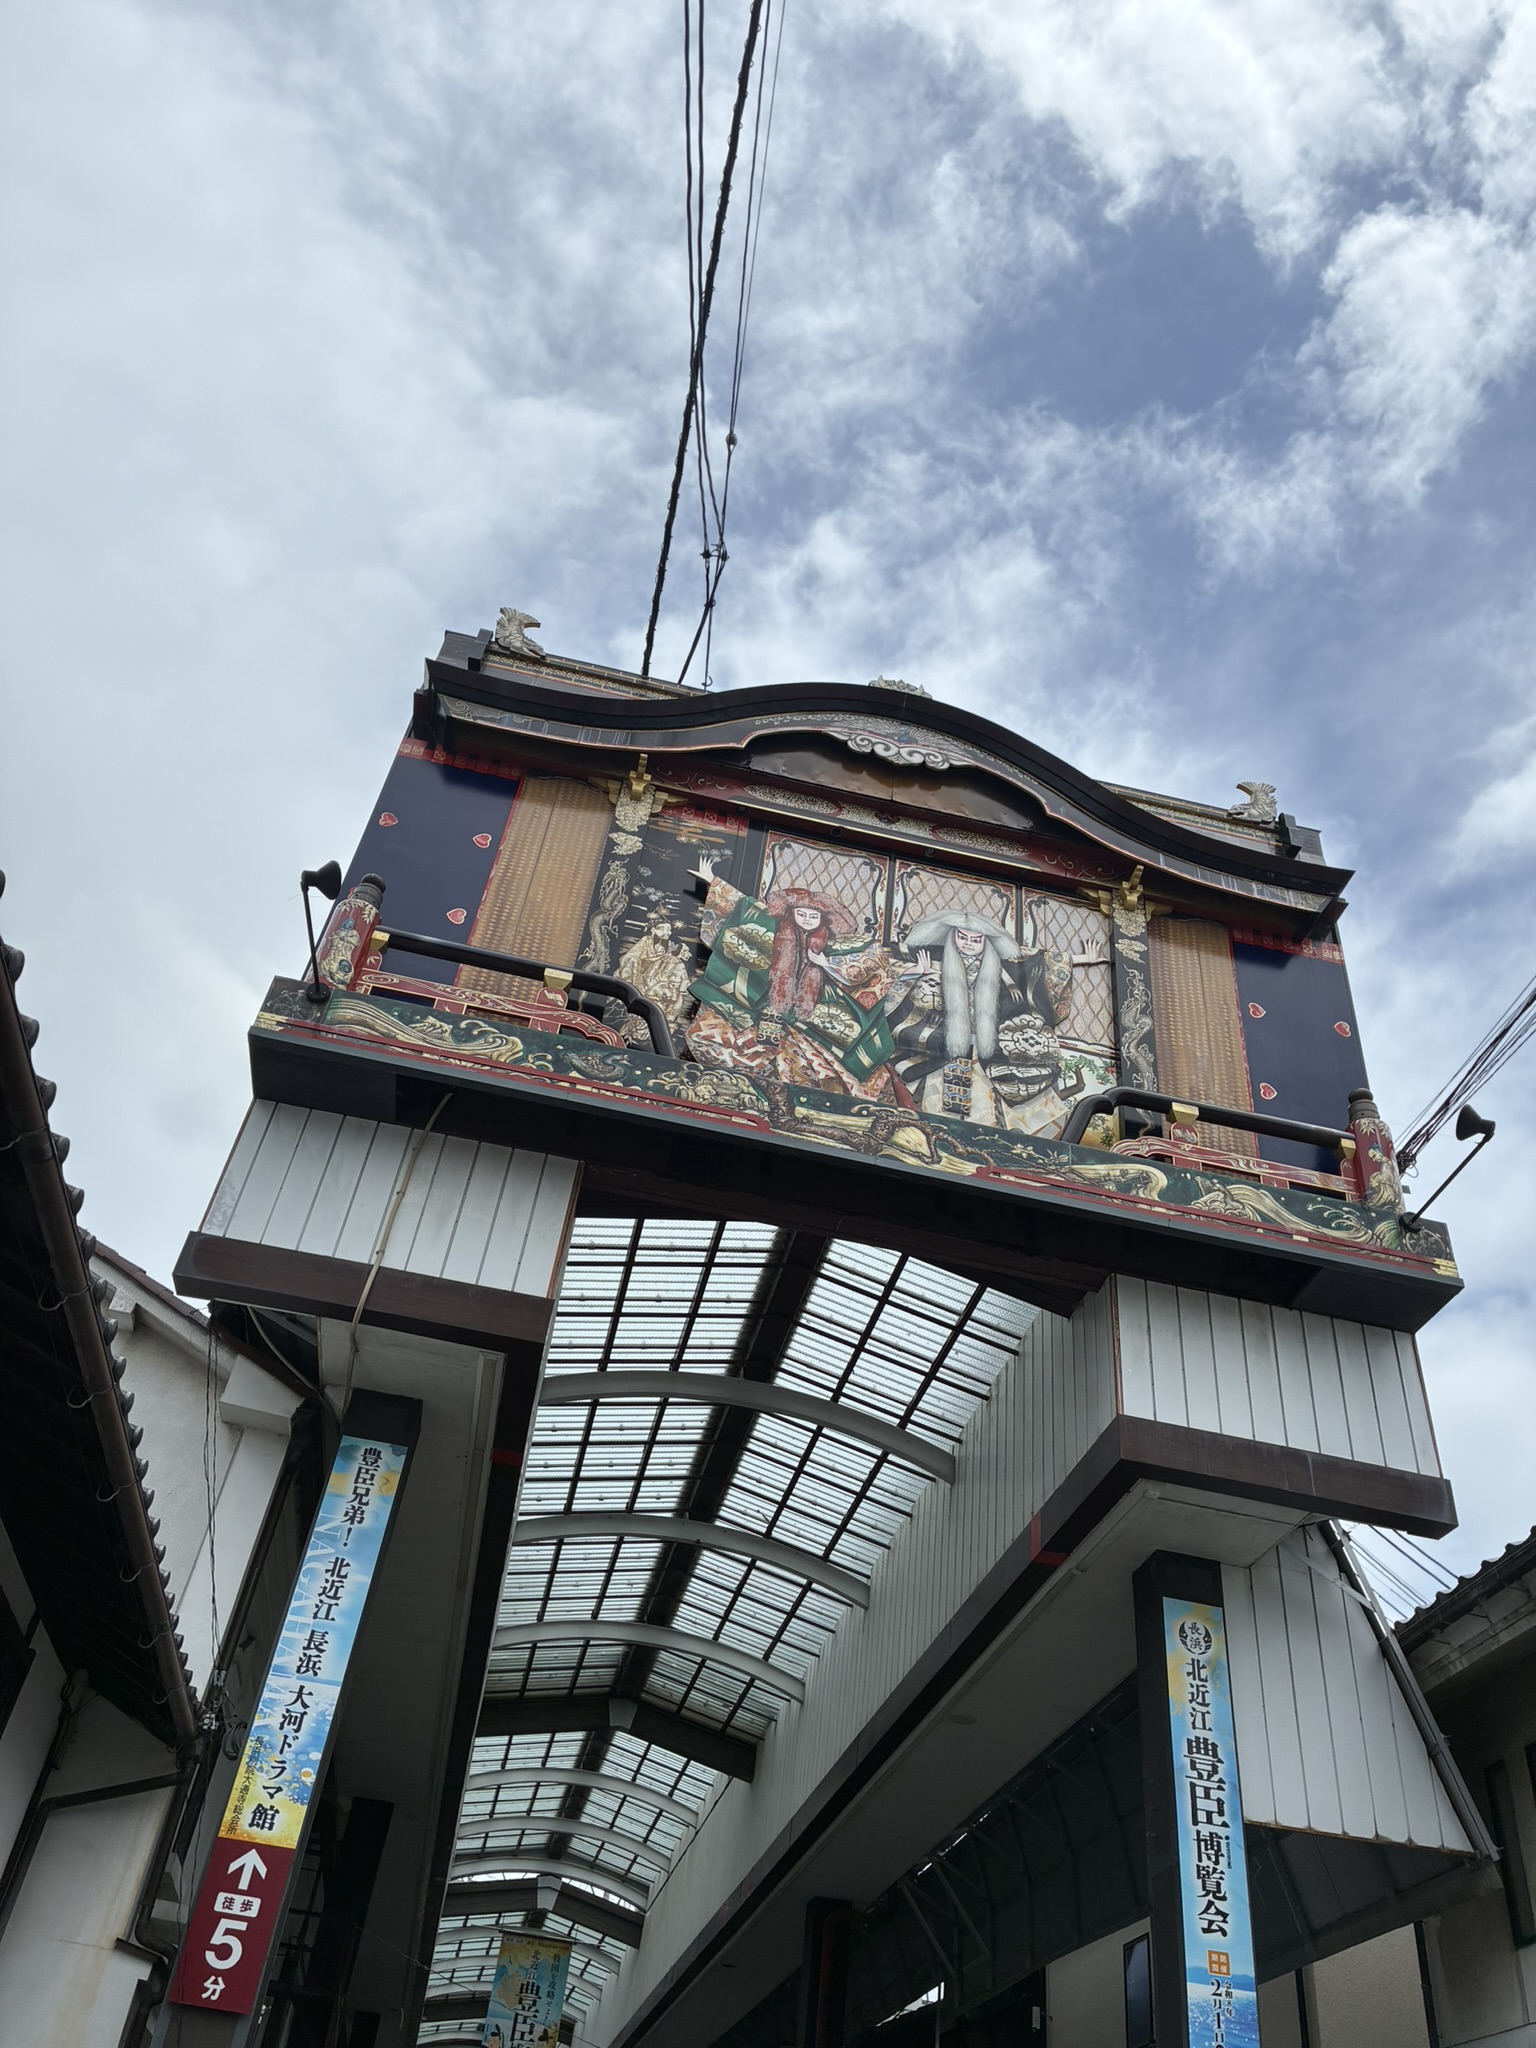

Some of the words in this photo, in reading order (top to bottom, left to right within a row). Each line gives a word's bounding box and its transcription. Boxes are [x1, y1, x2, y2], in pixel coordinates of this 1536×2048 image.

[341, 1447, 382, 1547] 豊臣兄弟！
[312, 1557, 351, 1621] 北近江
[296, 1629, 329, 1677] 長浜
[1188, 1622, 1202, 1650] 長浜
[248, 1685, 314, 1831] 大河ドラマ館
[221, 1896, 253, 1913] 徒歩
